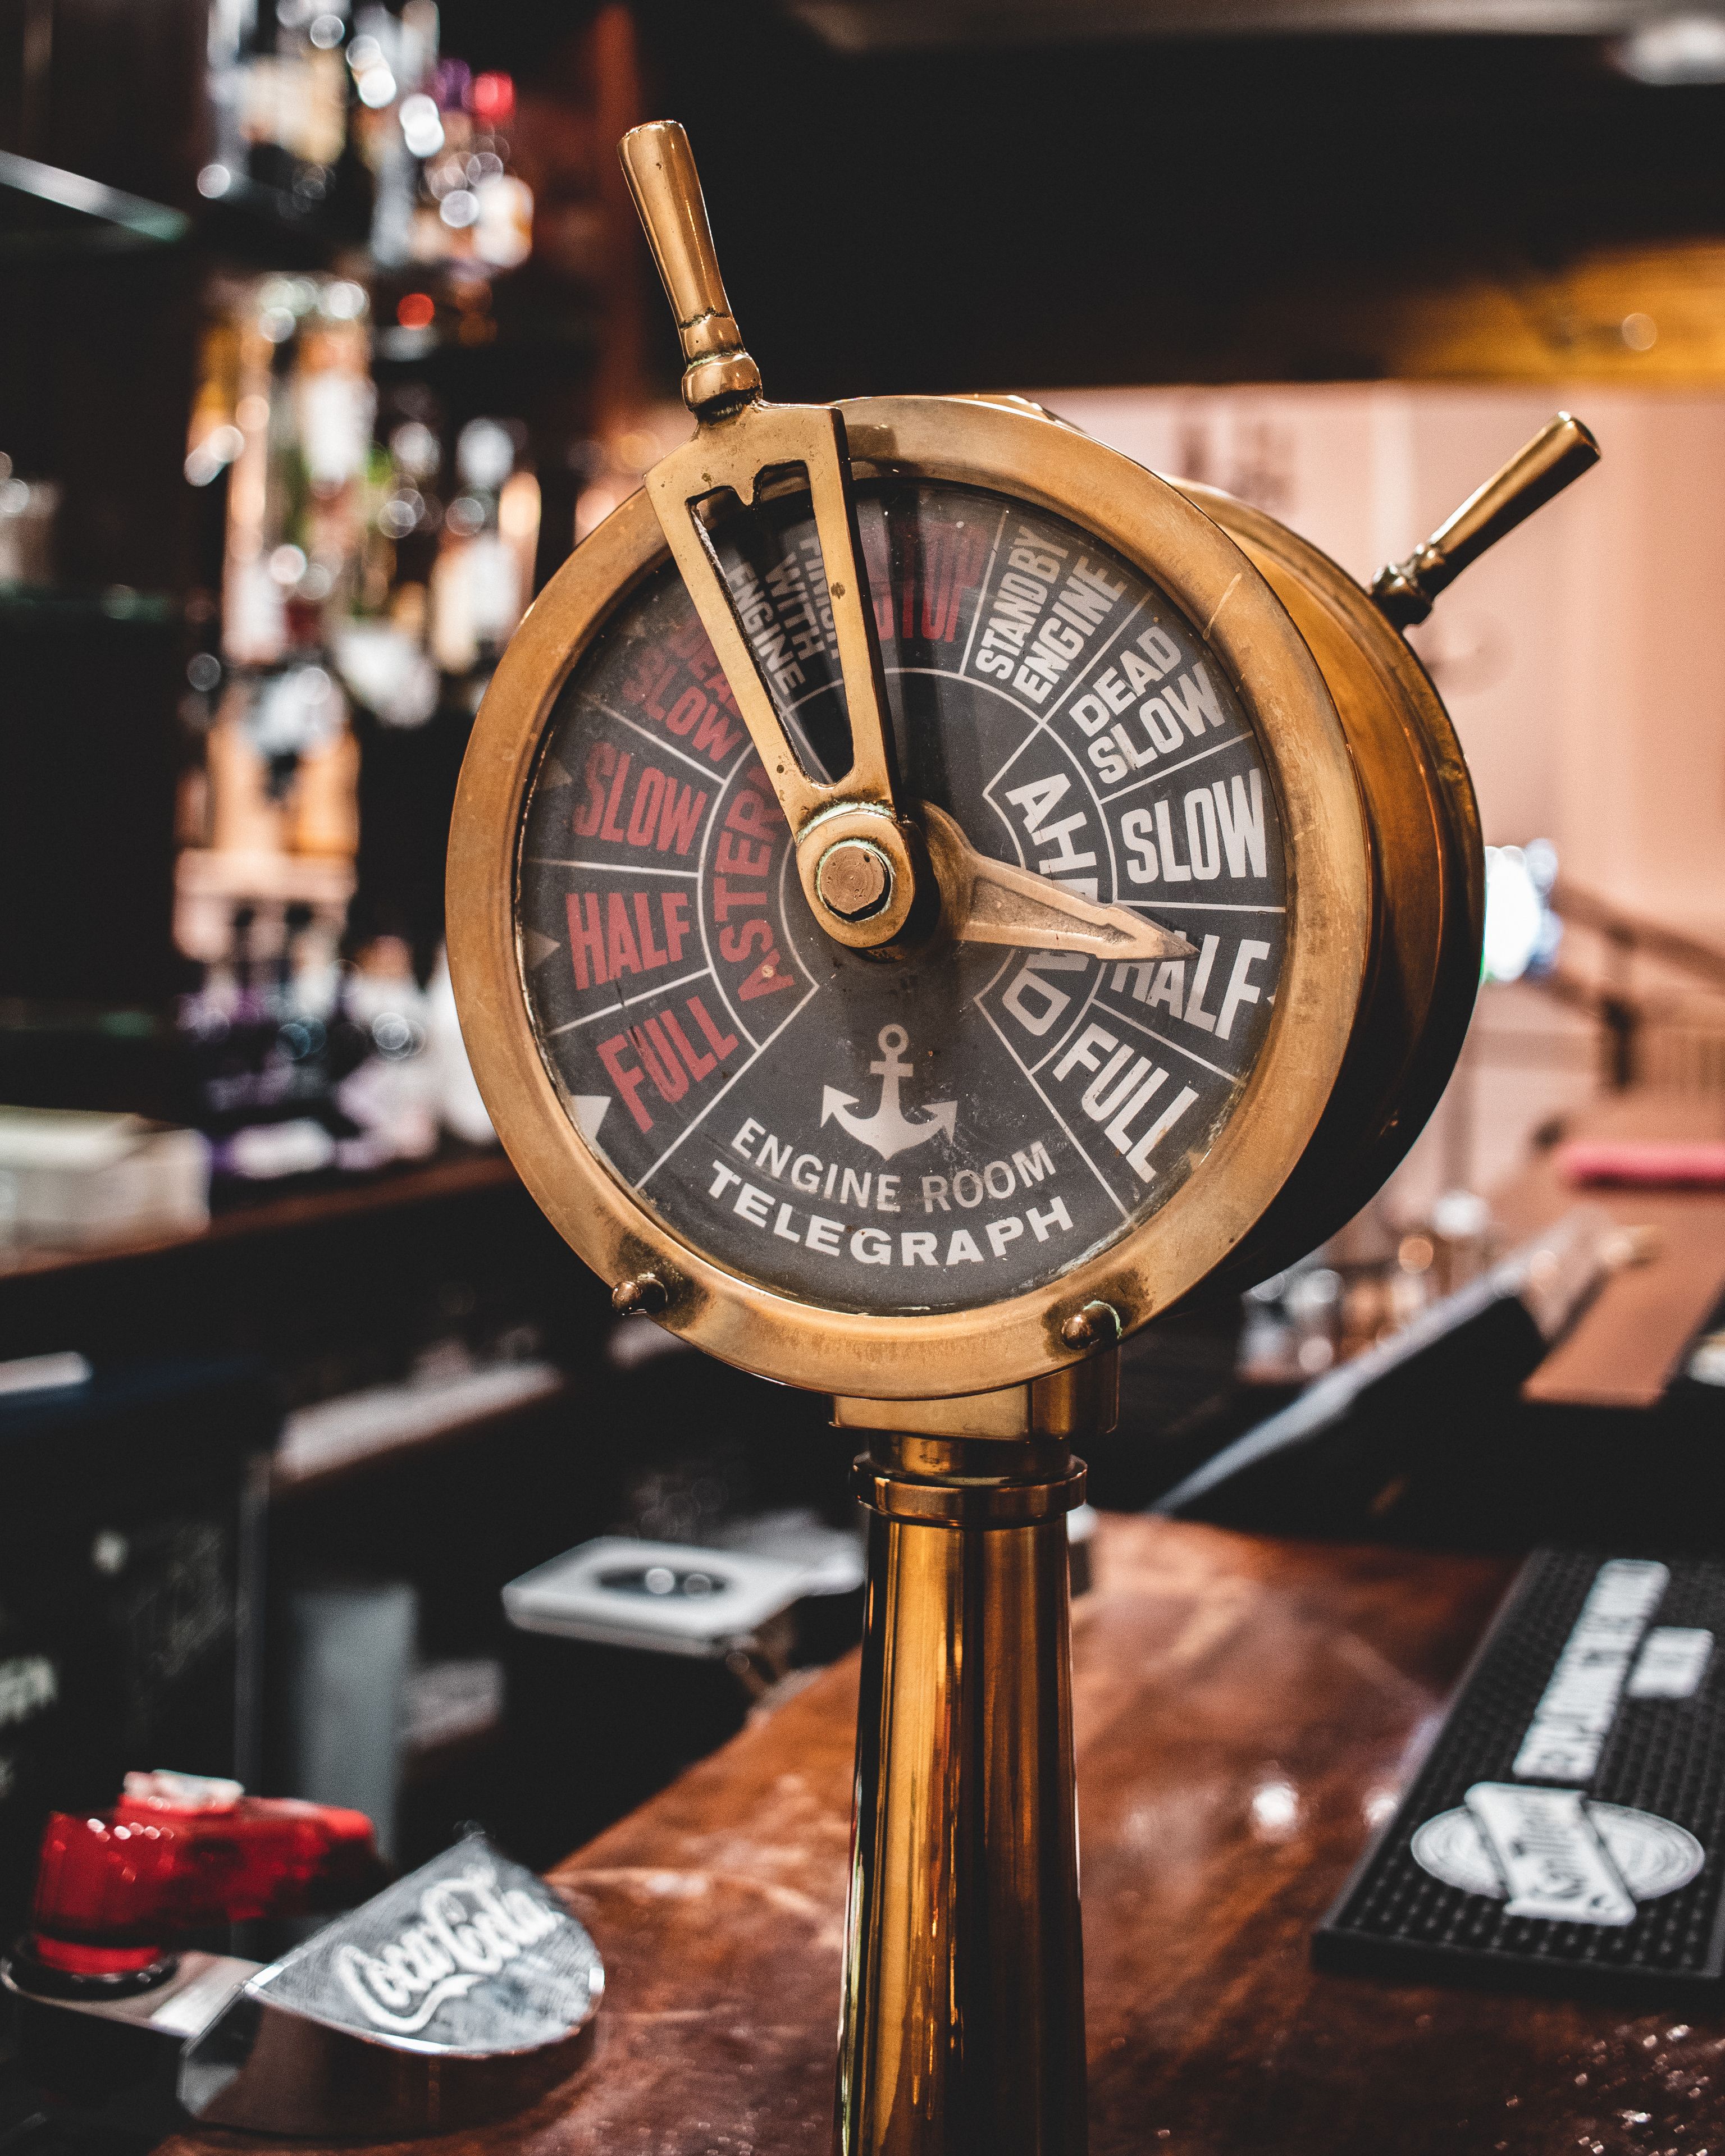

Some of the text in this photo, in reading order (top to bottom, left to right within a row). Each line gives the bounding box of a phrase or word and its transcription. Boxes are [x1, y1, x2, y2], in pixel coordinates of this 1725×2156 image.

[725, 562, 806, 695] ENGINE
[766, 554, 824, 660] WITH
[975, 526, 1071, 680] STANDBY
[1012, 555, 1128, 705] ENGINE
[622, 646, 744, 762] SLOW
[668, 615, 742, 720] DEA
[1069, 626, 1181, 737] DEAD
[1087, 661, 1226, 785] SLOW
[573, 742, 708, 856] SLOW
[1121, 768, 1267, 884] SLOW
[566, 891, 691, 990] HALF
[1001, 773, 1098, 1036] AHD
[596, 995, 739, 1134] FULL
[1053, 1022, 1199, 1184] FULL
[708, 1159, 1074, 1267] TELEGRAPH
[731, 1117, 1056, 1213] ENGINE ROOM
